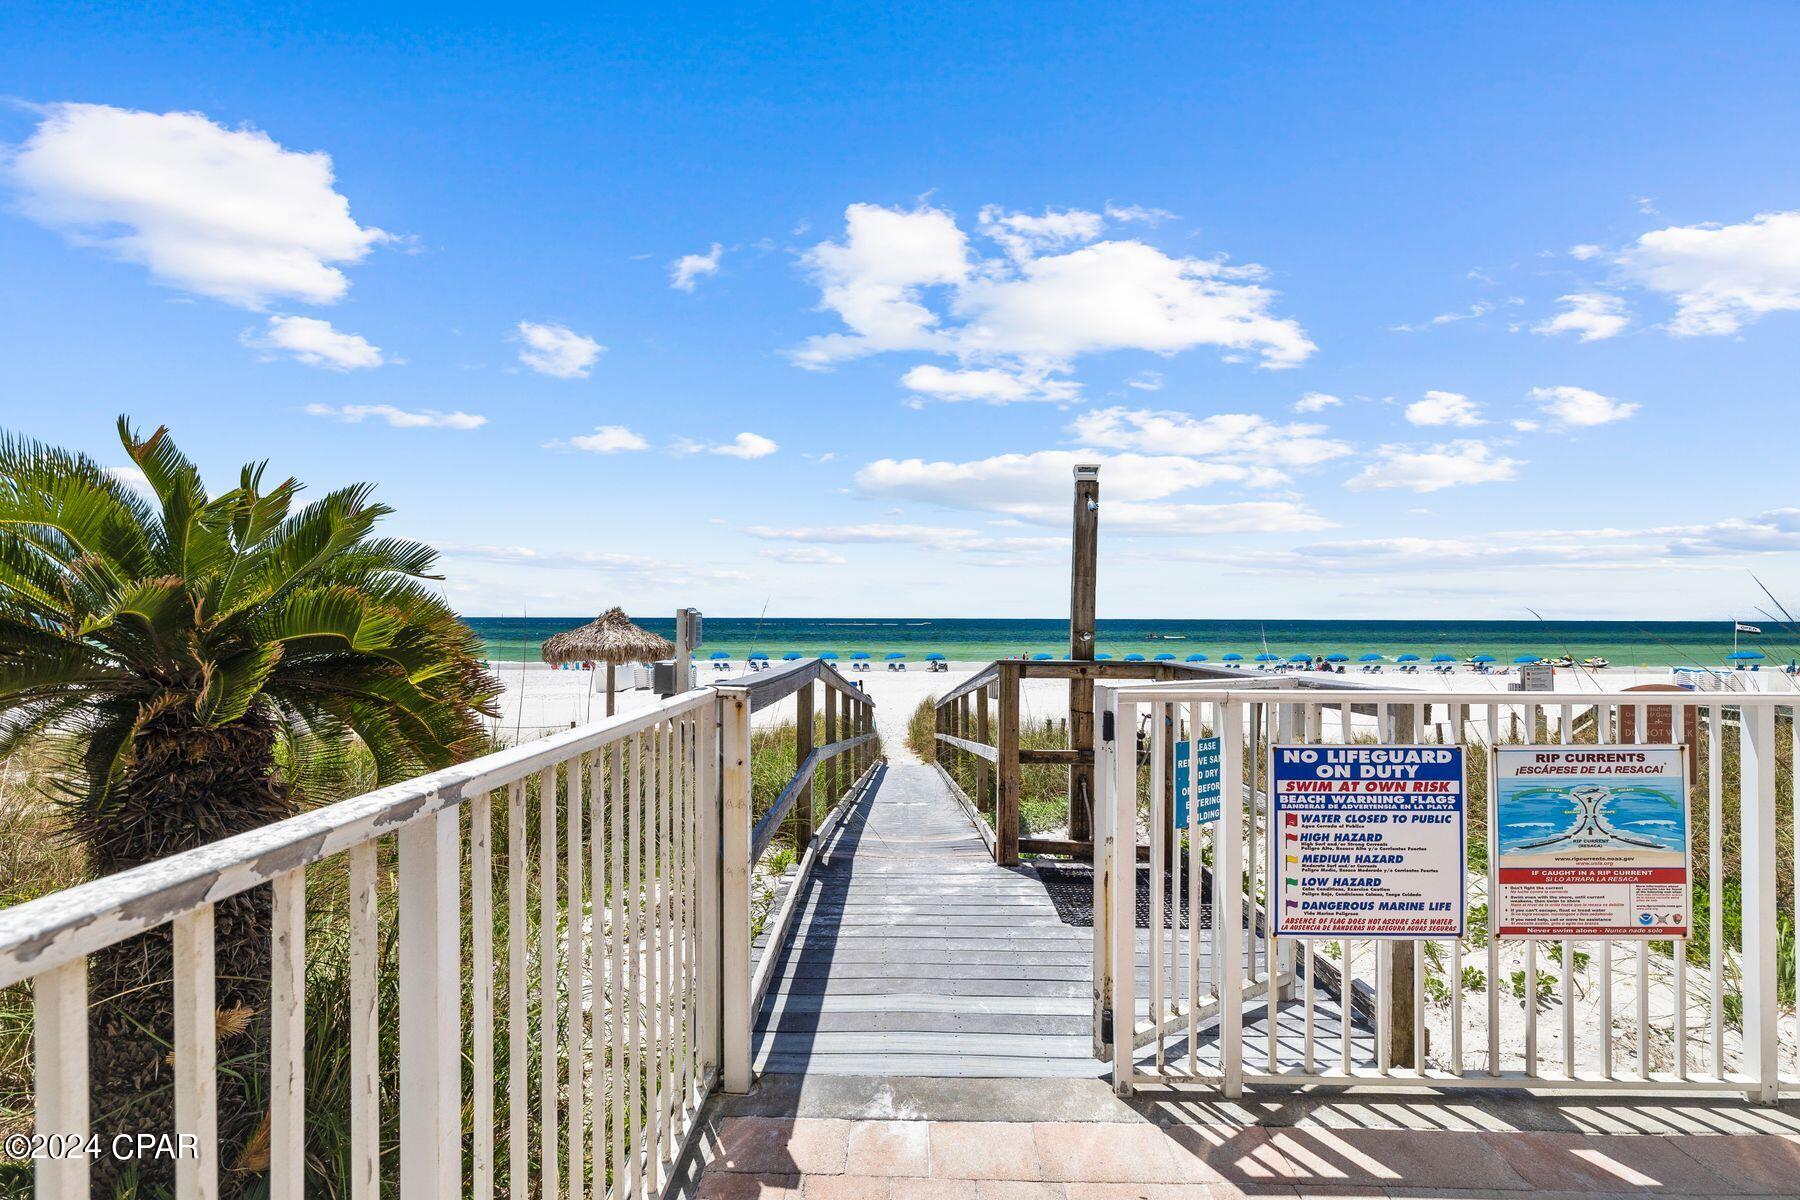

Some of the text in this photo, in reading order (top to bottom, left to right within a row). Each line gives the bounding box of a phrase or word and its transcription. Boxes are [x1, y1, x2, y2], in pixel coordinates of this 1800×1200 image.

[1196, 742, 1216, 752] EASE
[1283, 750, 1452, 764] NO LIFEGUARD
[1535, 753, 1646, 763] RIP CURRENTS
[1205, 769, 1218, 778] DRY
[1316, 765, 1420, 778] ON DUTY
[1515, 764, 1664, 776] ¡ESCÁPESE DE LA RESACA!
[1198, 782, 1221, 794] BEFOR
[1286, 781, 1451, 792] SWIM AT OWN RISK
[1279, 795, 1456, 803] BEACH WARNING FLAGS
[1301, 814, 1452, 823] WATER CLOSED TO PUBLIC
[1300, 833, 1383, 842] HIGH HAZARD
[1301, 855, 1404, 863] MEDIUM HAZARD
[1302, 878, 1382, 886] LOW HAZARD
[1302, 901, 1452, 911] DANGEROUS MARINE LIFE
